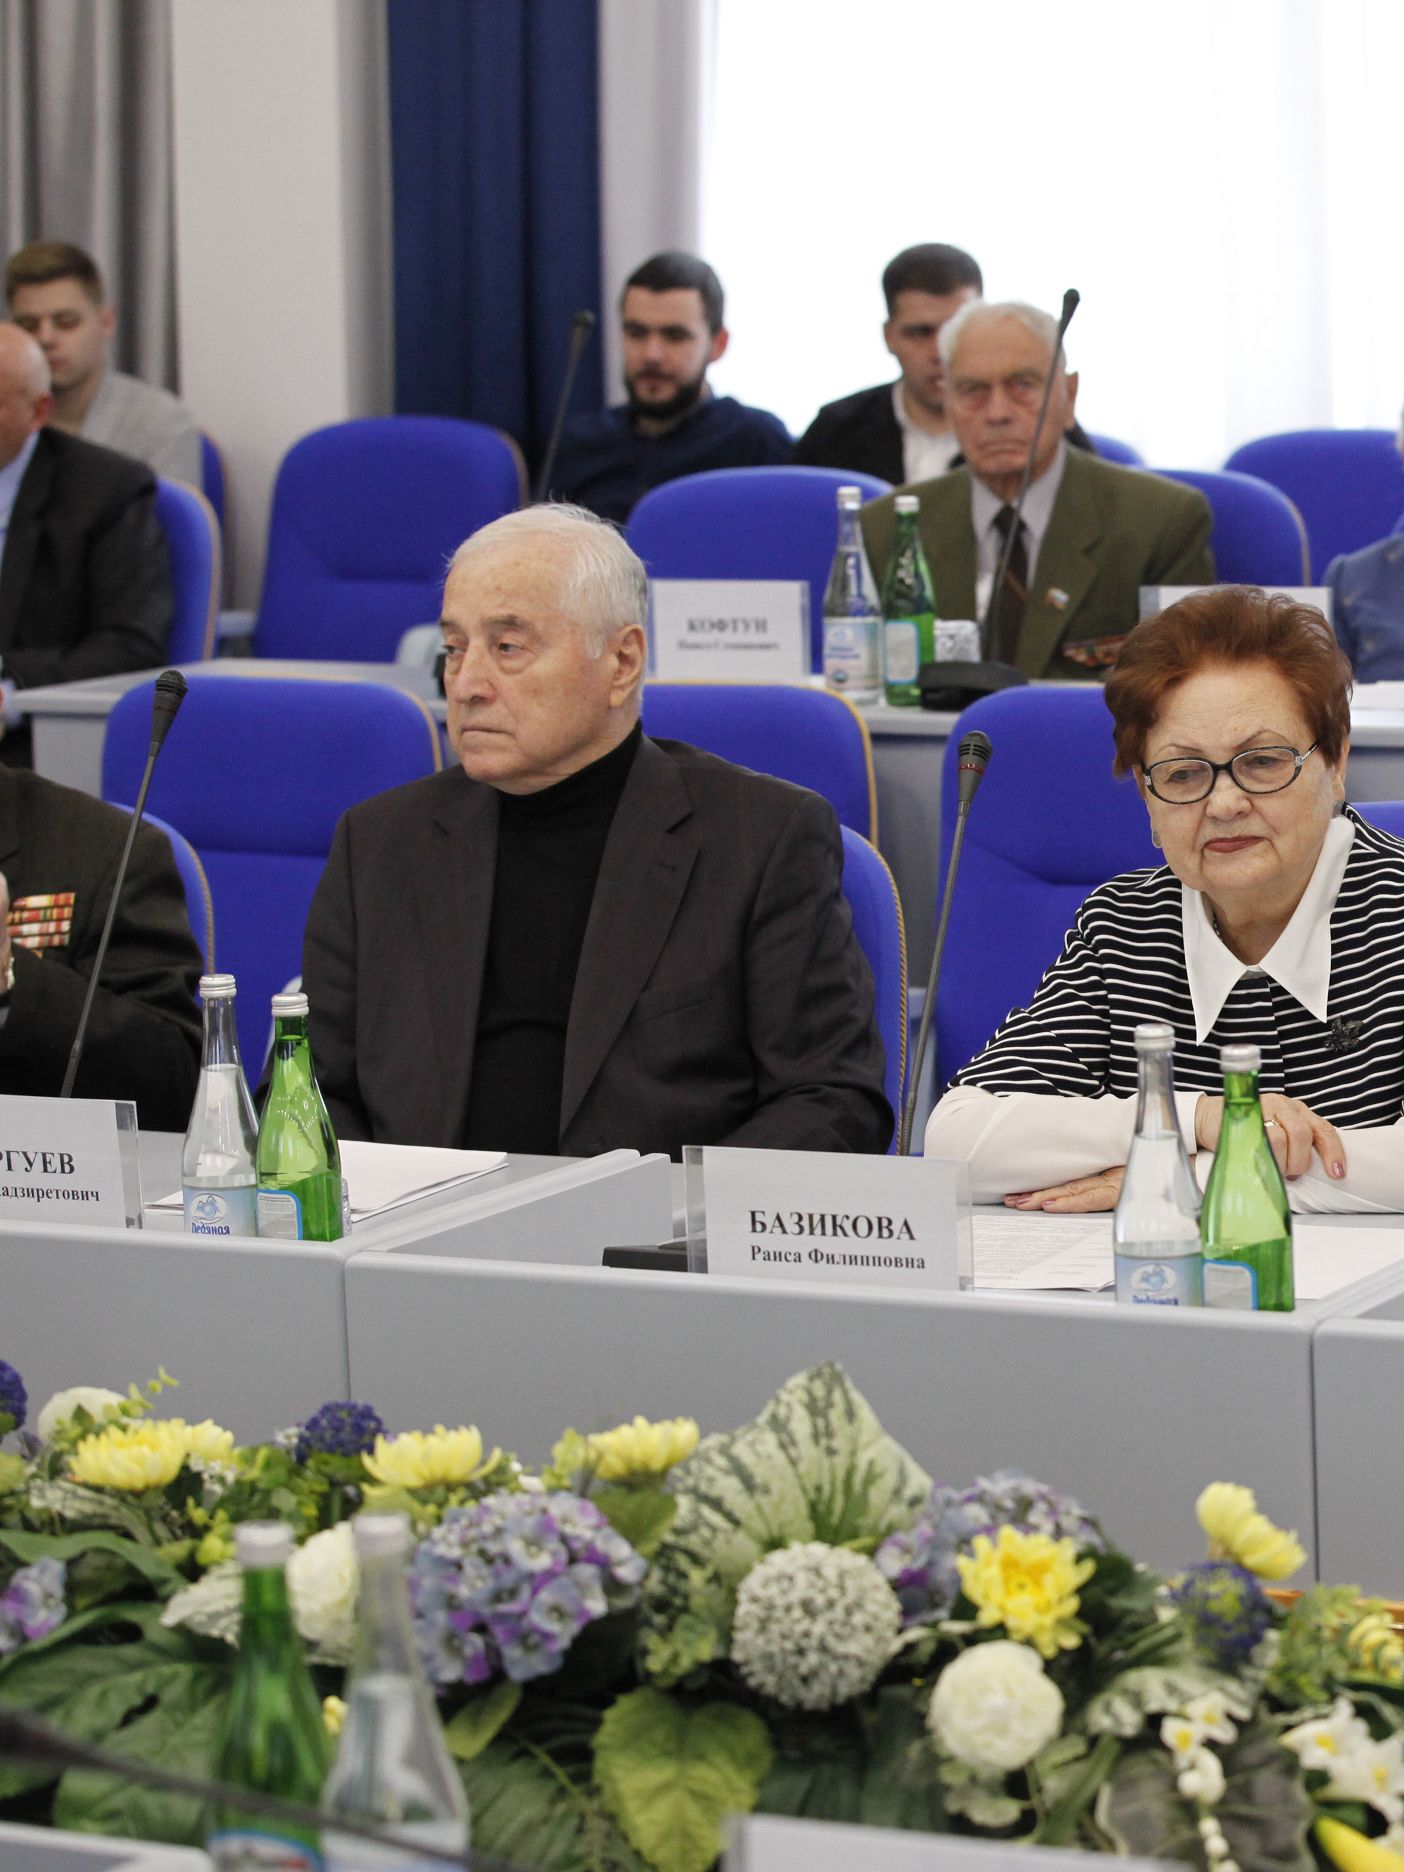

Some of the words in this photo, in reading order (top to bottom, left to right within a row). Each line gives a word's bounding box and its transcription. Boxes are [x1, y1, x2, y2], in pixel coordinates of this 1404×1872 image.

[0, 1150, 75, 1175] ГУЕВ
[0, 1186, 100, 1202] адзиретович
[749, 1210, 916, 1241] БАЗИКОВА
[751, 1245, 802, 1264] Раиса
[808, 1248, 926, 1270] Филипповна
